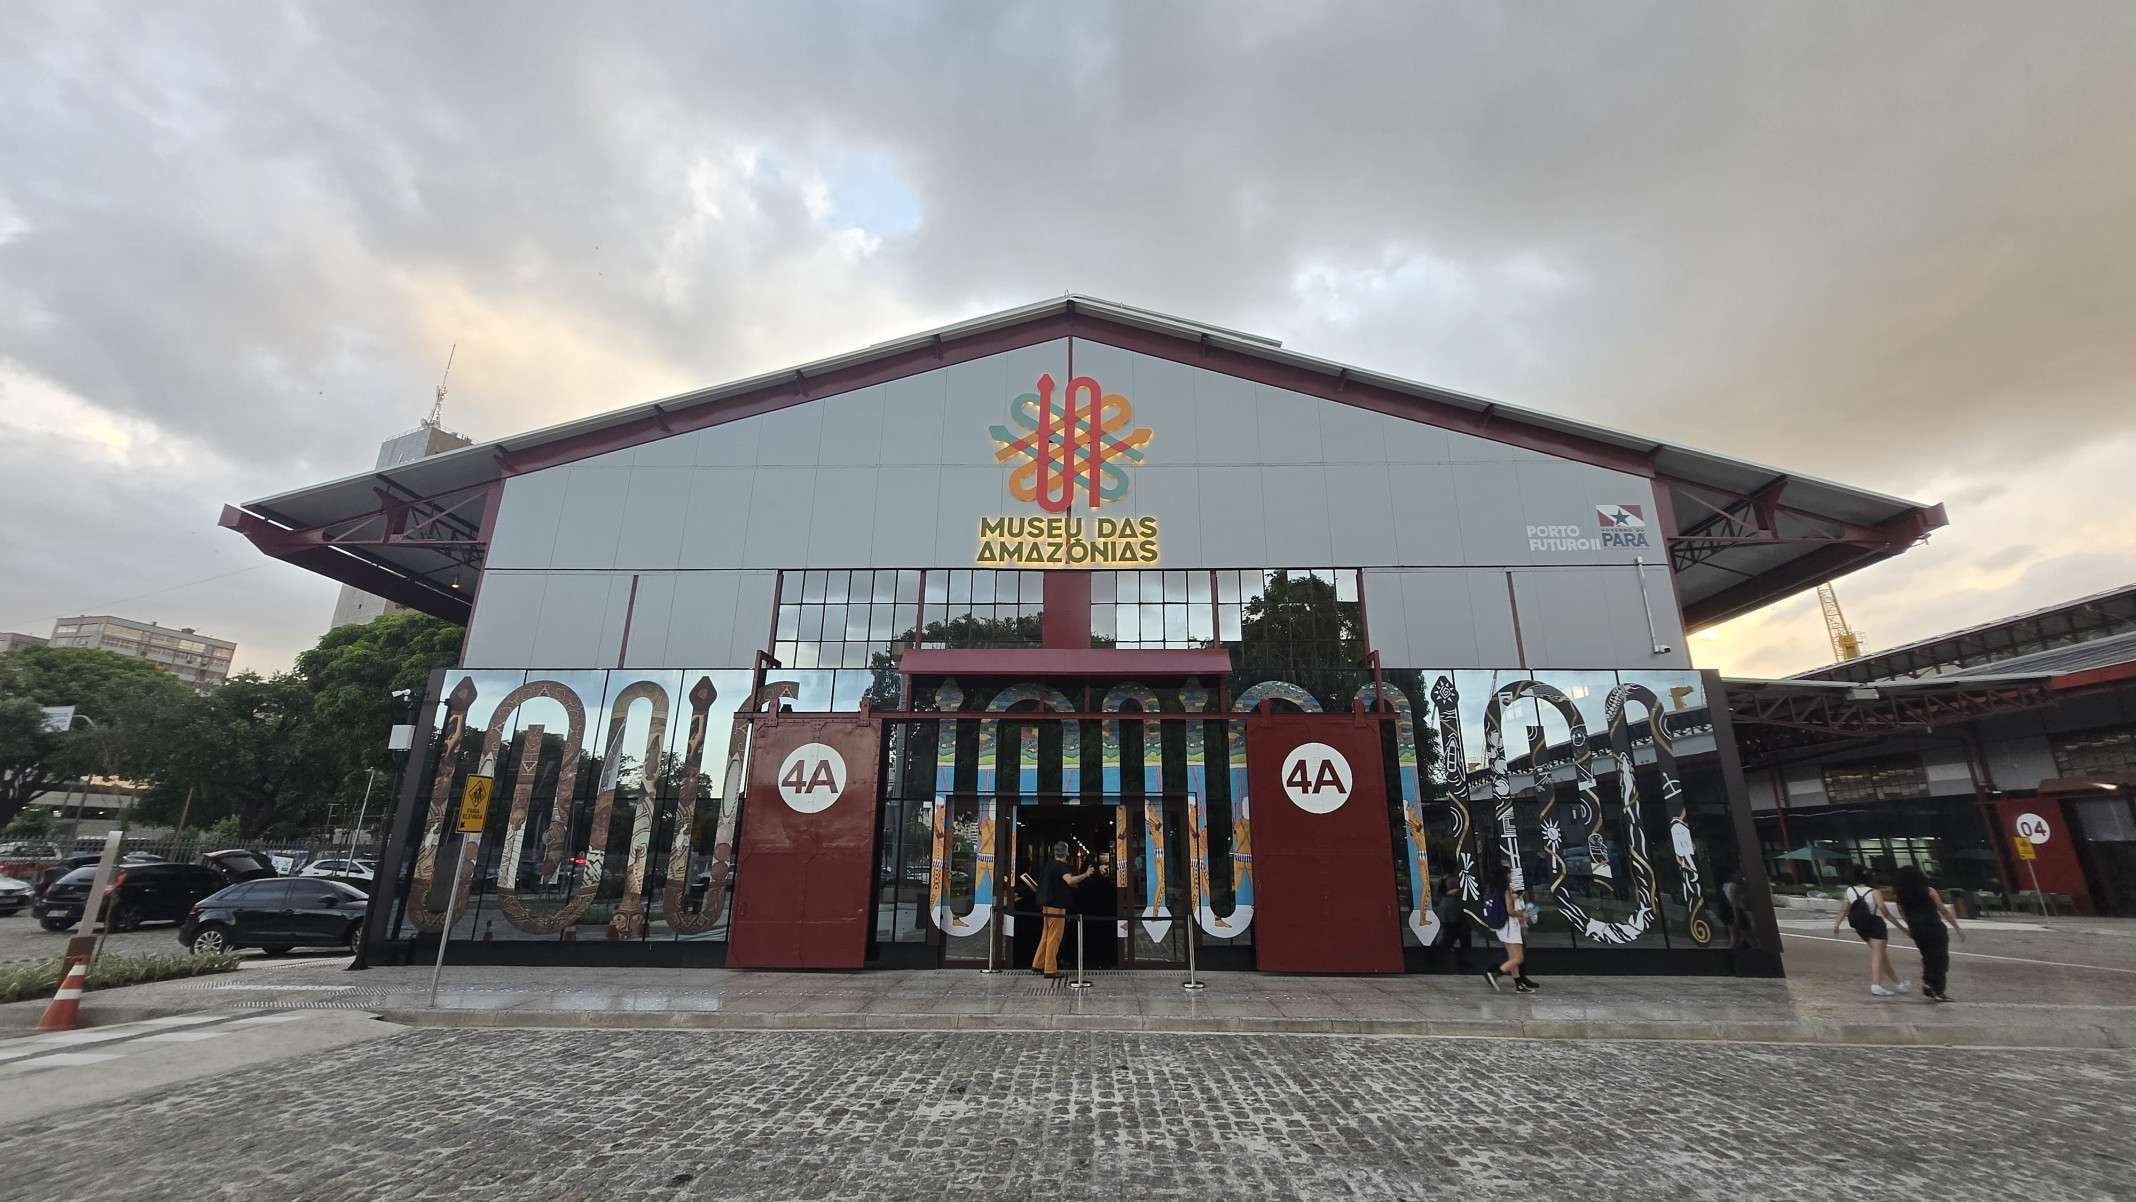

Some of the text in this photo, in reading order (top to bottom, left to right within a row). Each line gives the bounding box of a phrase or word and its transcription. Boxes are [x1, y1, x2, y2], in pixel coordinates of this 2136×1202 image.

[980, 516, 1157, 539] MUSEU DAS
[1526, 525, 1580, 538] PORTO
[1529, 538, 1590, 551] FUTURO
[781, 759, 839, 794] 4A
[1286, 759, 1347, 794] 4A
[2020, 820, 2047, 837] 04
